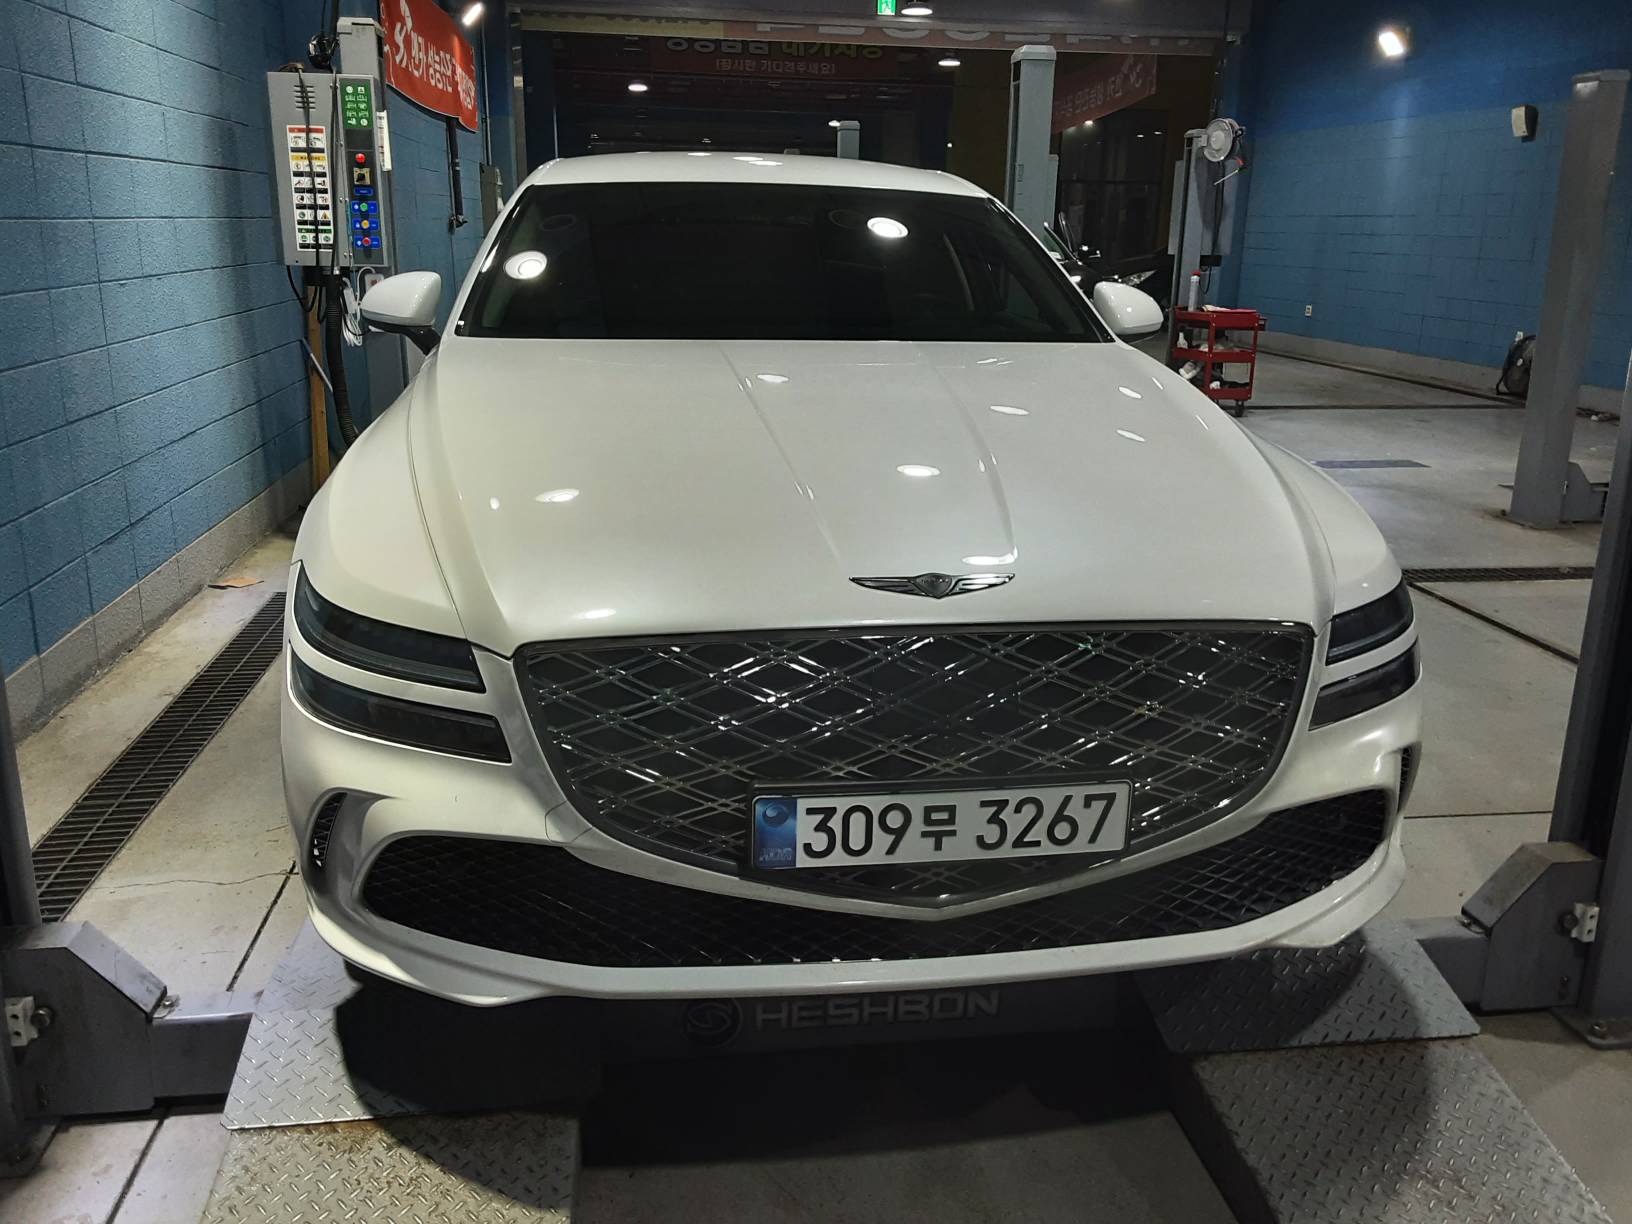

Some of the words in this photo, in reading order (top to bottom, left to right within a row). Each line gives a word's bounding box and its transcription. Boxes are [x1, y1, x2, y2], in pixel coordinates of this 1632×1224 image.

[802, 802, 957, 859] 309무
[976, 792, 1117, 851] 3267
[757, 991, 999, 1031] HESHBON
